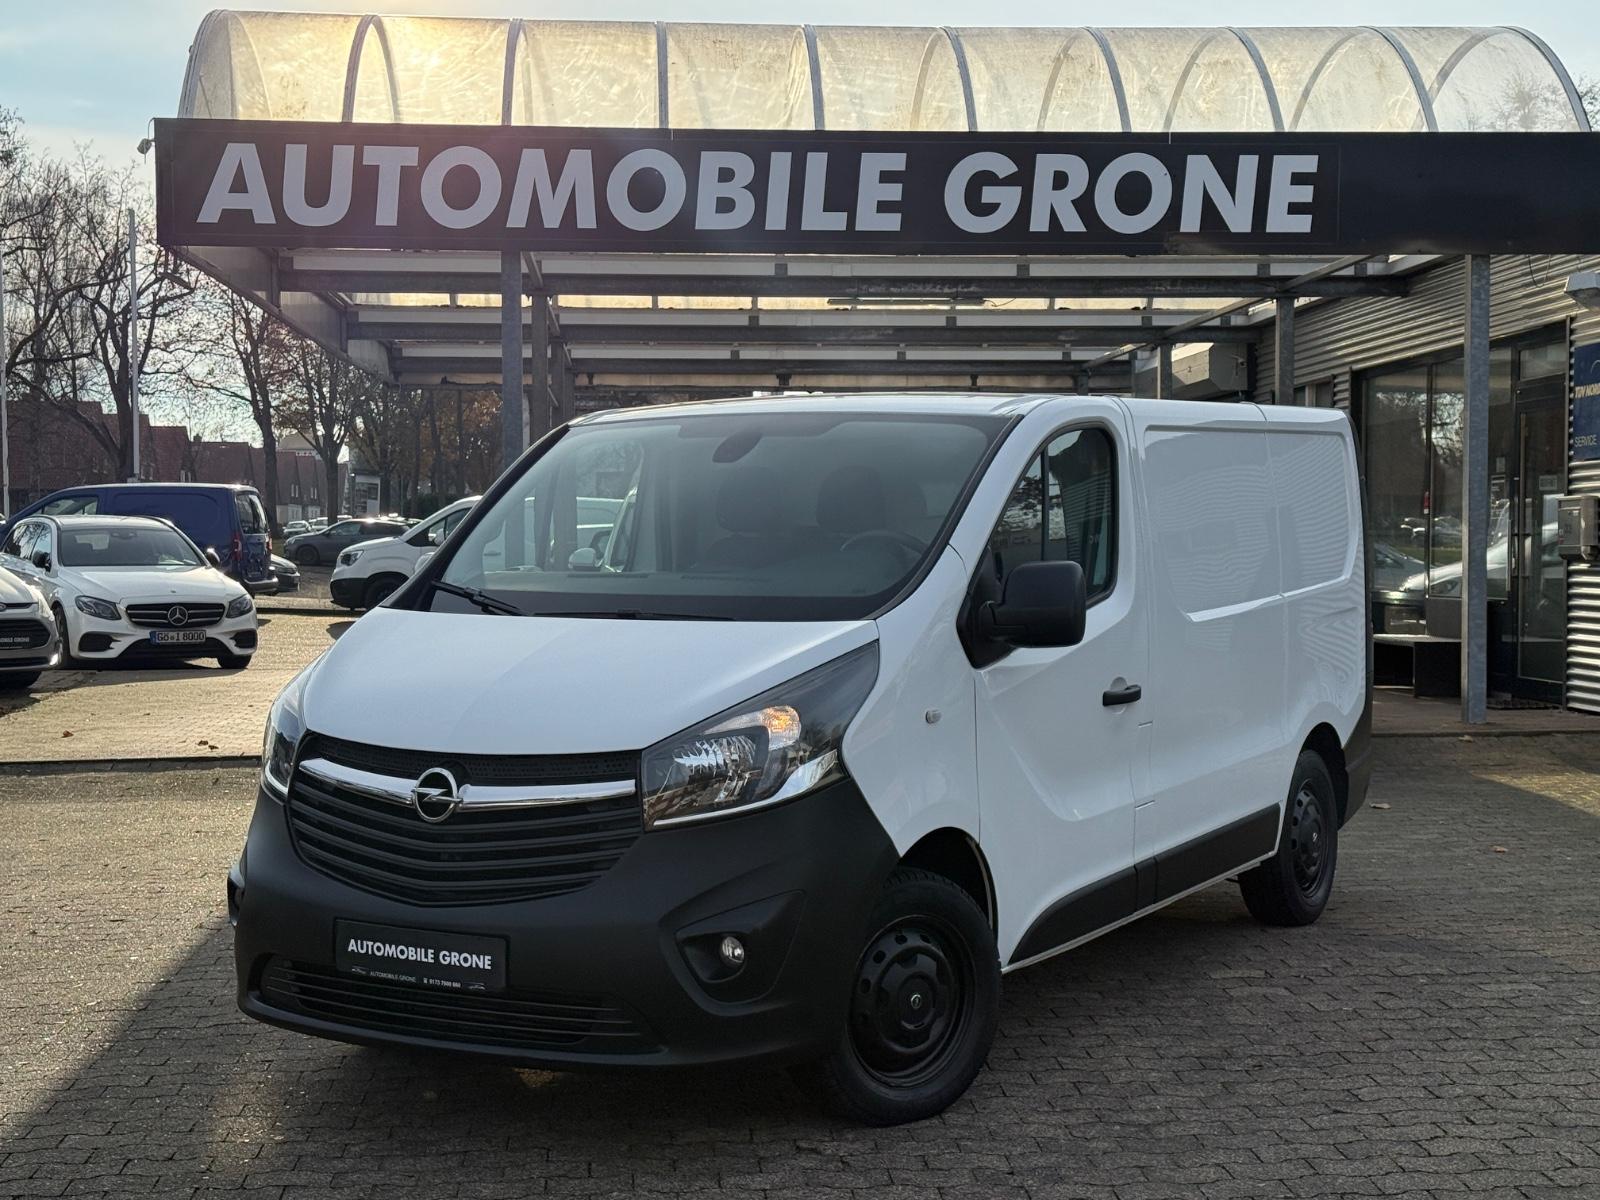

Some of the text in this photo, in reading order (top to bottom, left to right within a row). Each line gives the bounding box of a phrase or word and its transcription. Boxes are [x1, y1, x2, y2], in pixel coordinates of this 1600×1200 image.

[196, 142, 1320, 235] AUTOMOBILE GRONE
[1574, 434, 1597, 448] SERVICE
[347, 938, 492, 970] AUTOMOBILE GRONE
